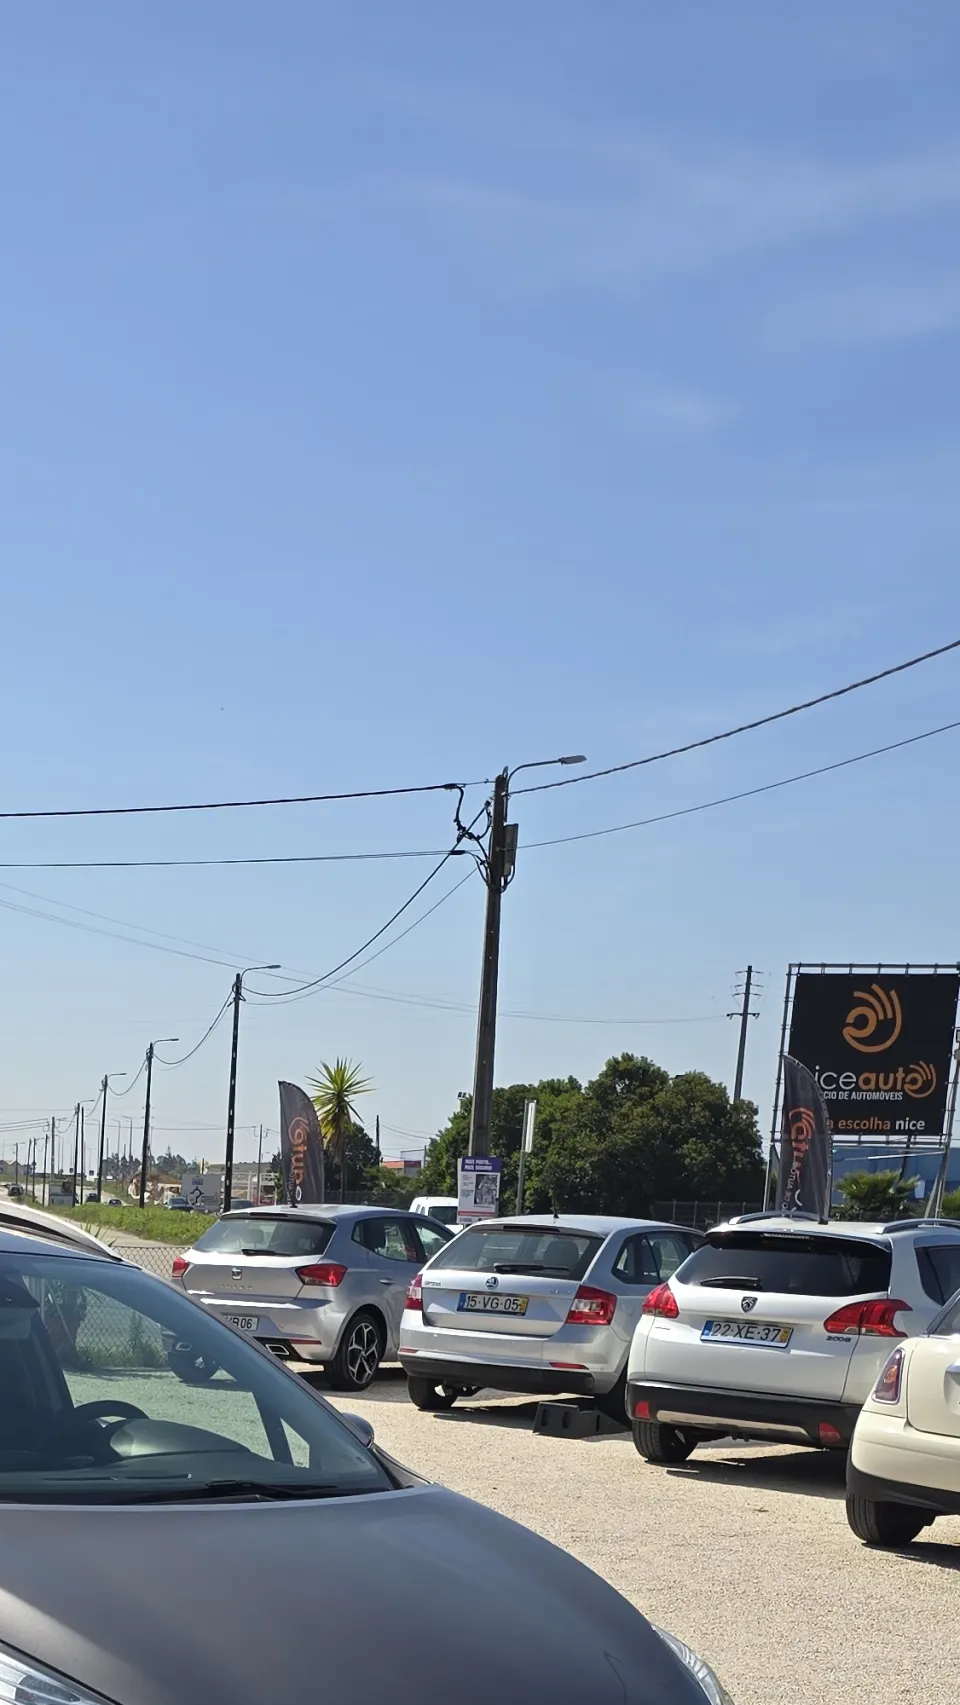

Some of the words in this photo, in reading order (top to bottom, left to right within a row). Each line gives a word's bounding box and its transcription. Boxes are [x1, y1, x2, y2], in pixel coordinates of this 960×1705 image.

[839, 1091, 849, 1100] DE
[850, 1090, 904, 1101] AUTOMÓVEIS
[838, 1117, 891, 1131] escolha
[895, 1117, 926, 1131] nice
